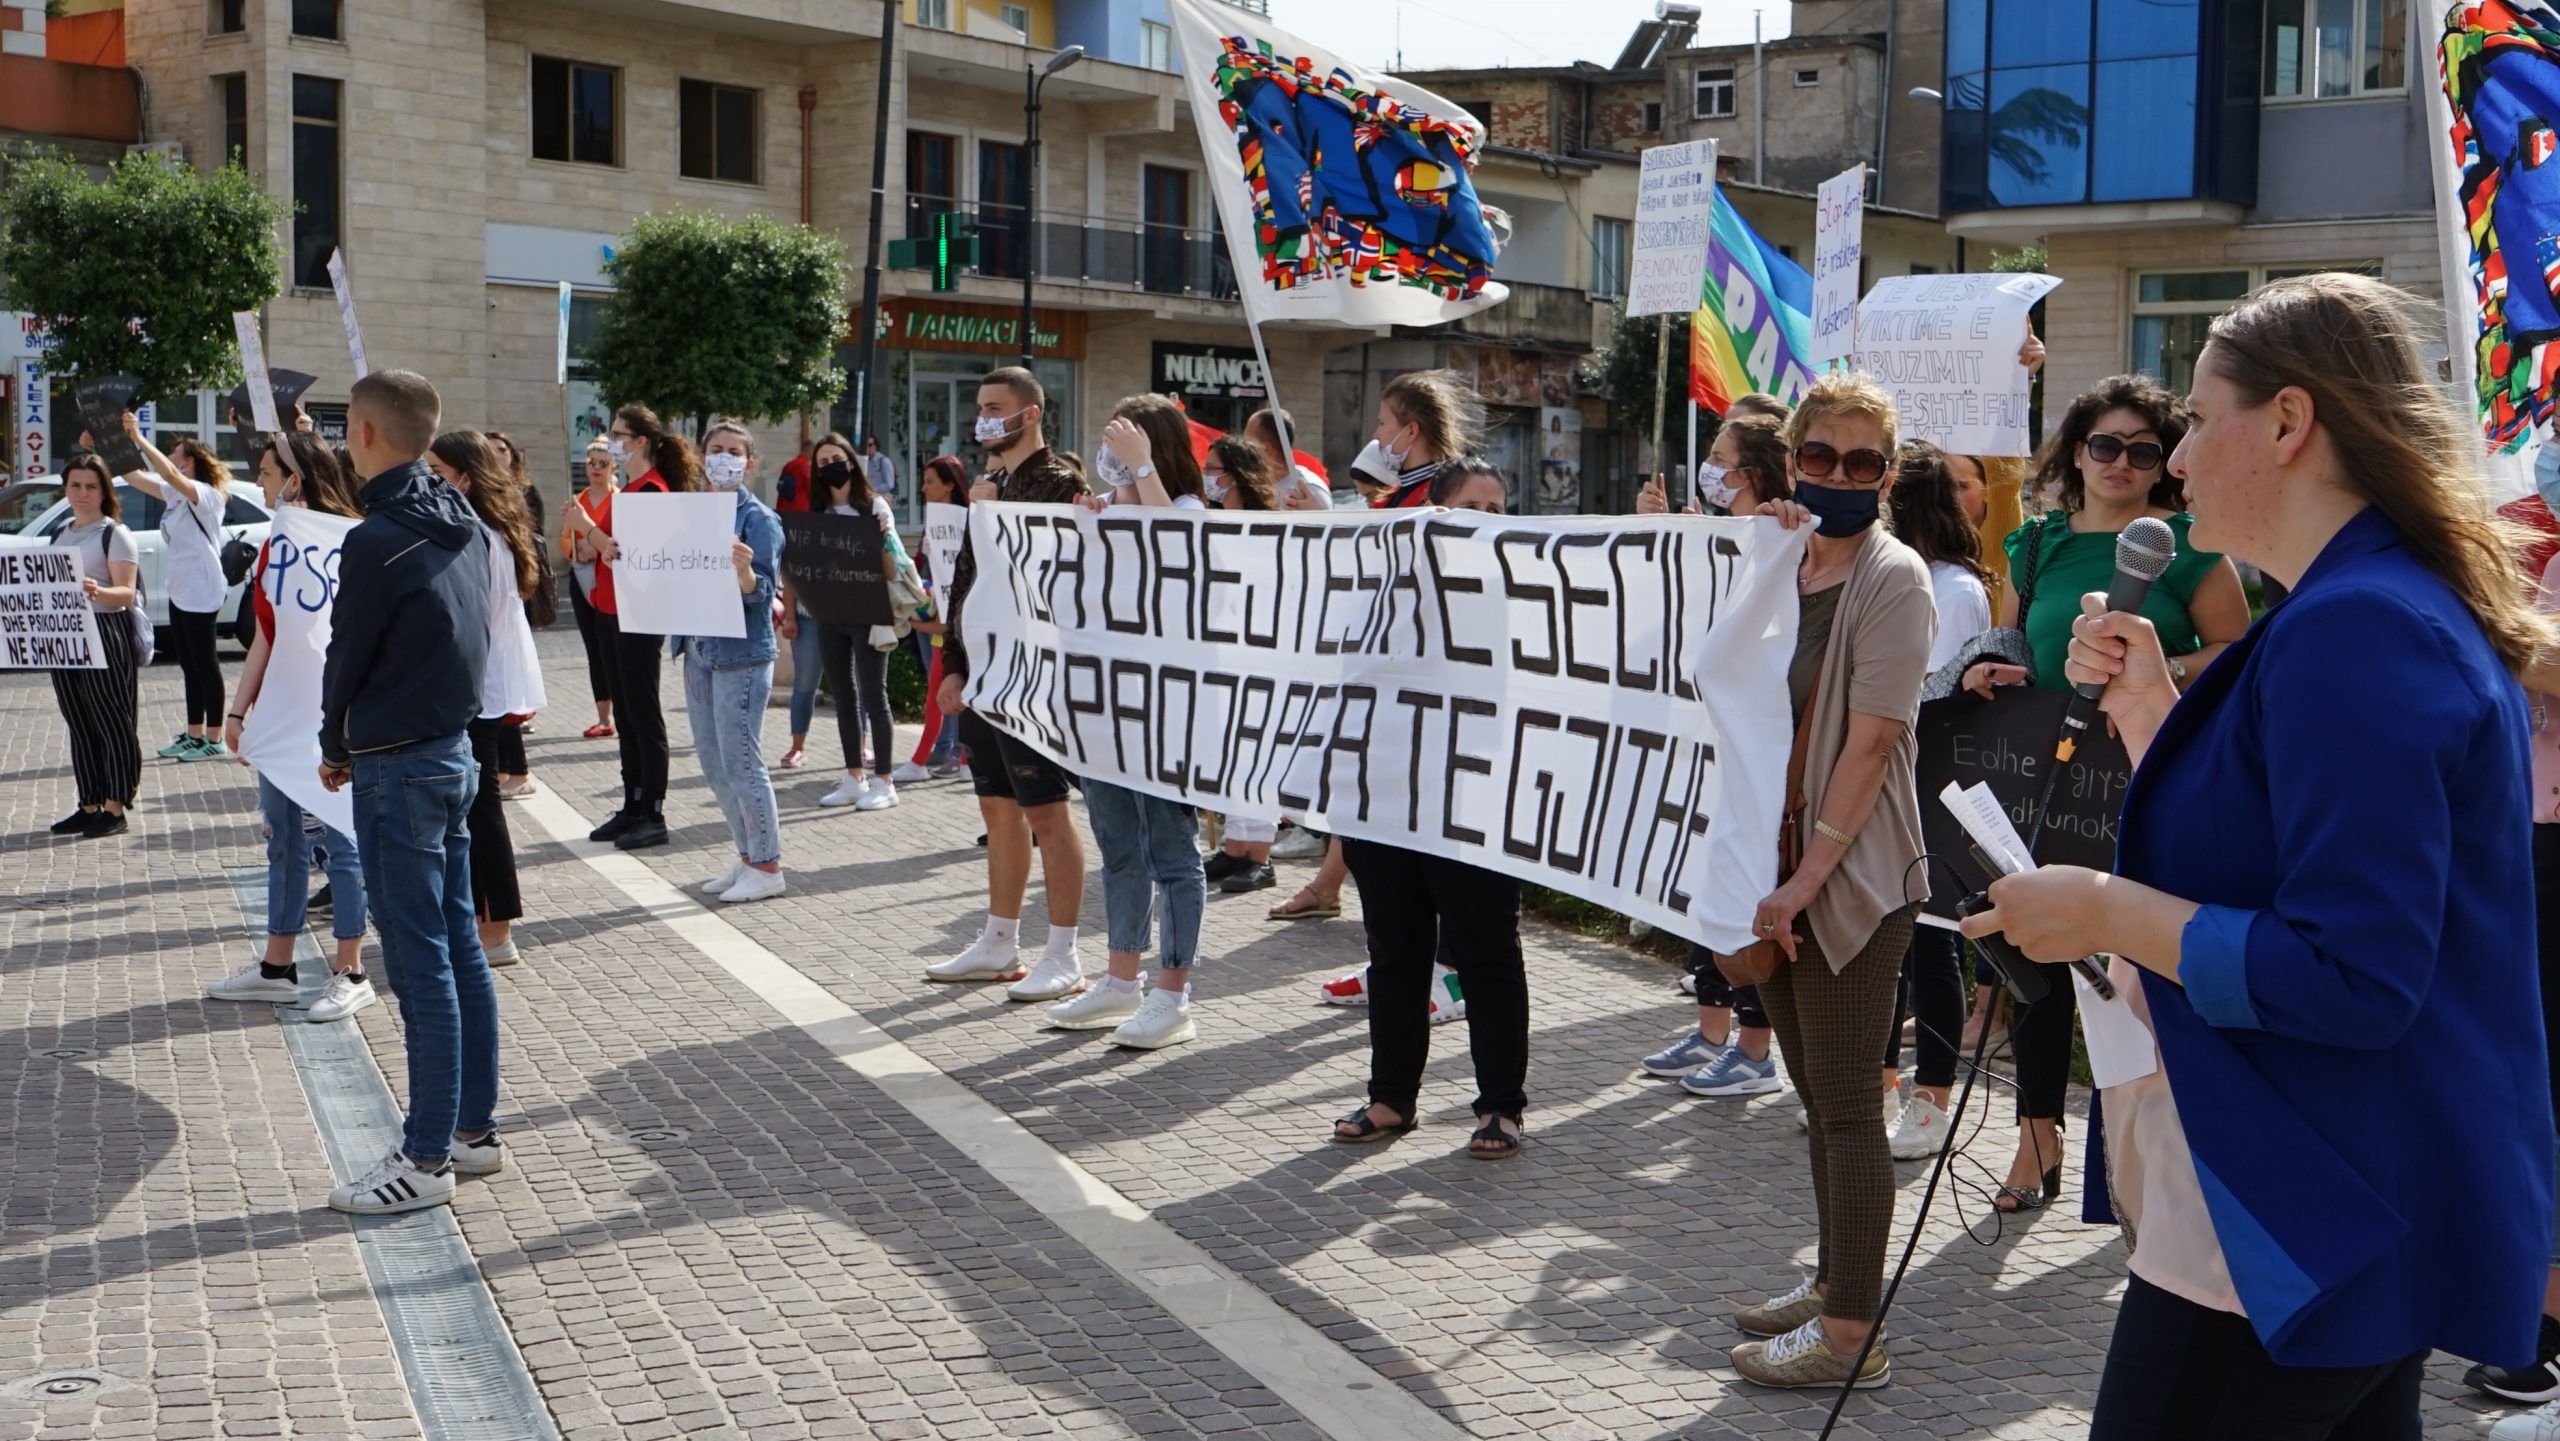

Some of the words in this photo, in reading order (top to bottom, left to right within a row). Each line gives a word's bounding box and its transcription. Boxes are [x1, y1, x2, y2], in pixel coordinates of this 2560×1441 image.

[905, 312, 1018, 345] FARMACI
[1723, 262, 1809, 402] PA
[1970, 306, 1995, 340] E
[1853, 350, 1983, 385] ABUZIMIT
[26, 432, 46, 480] AVIO
[23, 554, 76, 583] SHUME
[627, 547, 674, 571] Kush
[995, 513, 1086, 630] NGA
[1097, 517, 1425, 657] DREJTESIA
[1423, 519, 1494, 666] E
[2, 615, 28, 633] DHE
[29, 613, 84, 632] PSIKOLOGE
[6, 637, 29, 666] NE
[30, 637, 93, 666] SHKOLLA
[1953, 734, 2036, 777] Edhe
[968, 631, 1069, 758] LIND
[1063, 651, 1276, 798] PAQJA
[1396, 688, 1498, 846] TE
[1502, 705, 1717, 916] GJITHE
